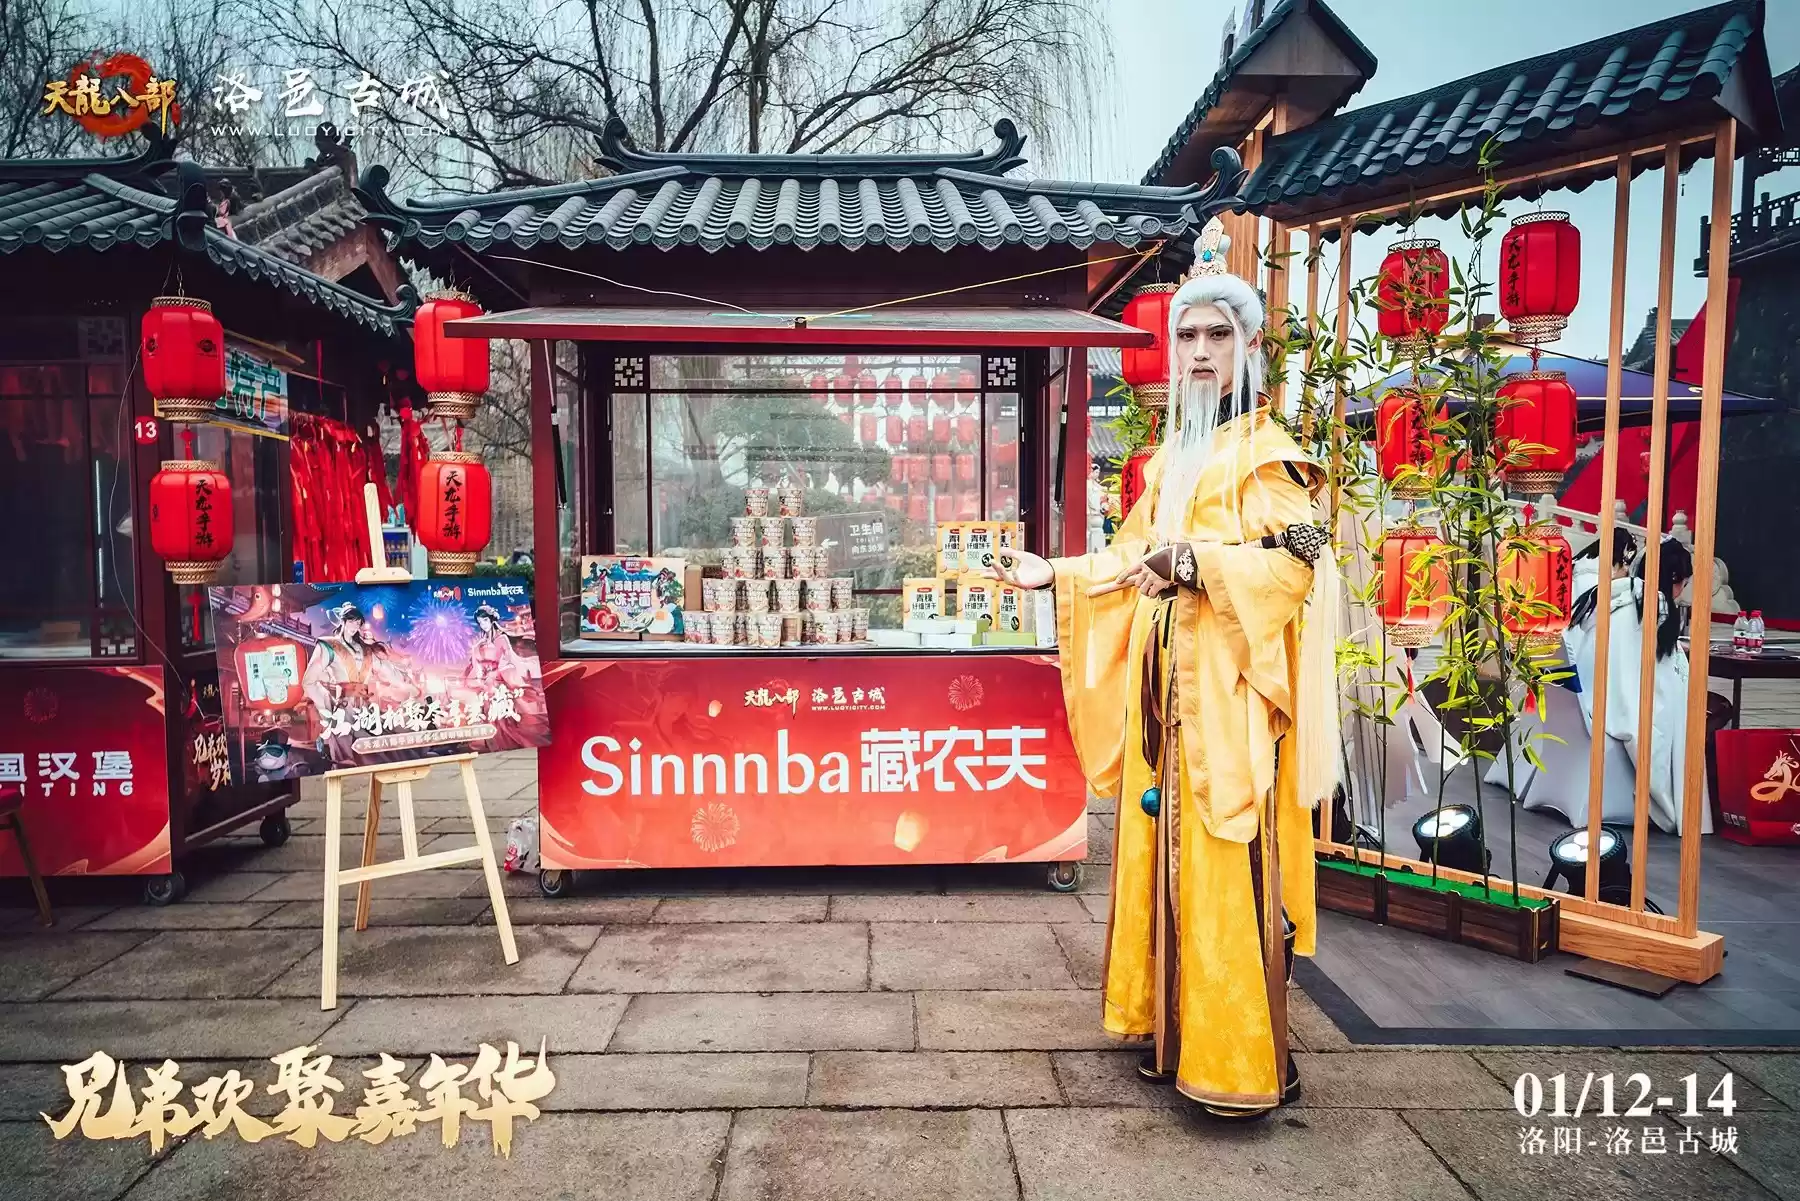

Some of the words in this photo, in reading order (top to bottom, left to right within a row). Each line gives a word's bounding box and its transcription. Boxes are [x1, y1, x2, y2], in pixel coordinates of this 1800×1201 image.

[1505, 235, 1521, 308] 天龙手游
[216, 348, 283, 421] 特产
[134, 421, 157, 439] 13
[195, 479, 214, 547] 天龙手游
[442, 470, 463, 540] 天龙手游
[849, 522, 884, 537] 卫生间
[467, 586, 502, 598] Sinnnba
[1554, 545, 1569, 621] 天龙手游
[811, 686, 886, 705] 洛邑古城
[580, 728, 850, 797] Sinnnba
[860, 725, 1047, 794] 藏农夫
